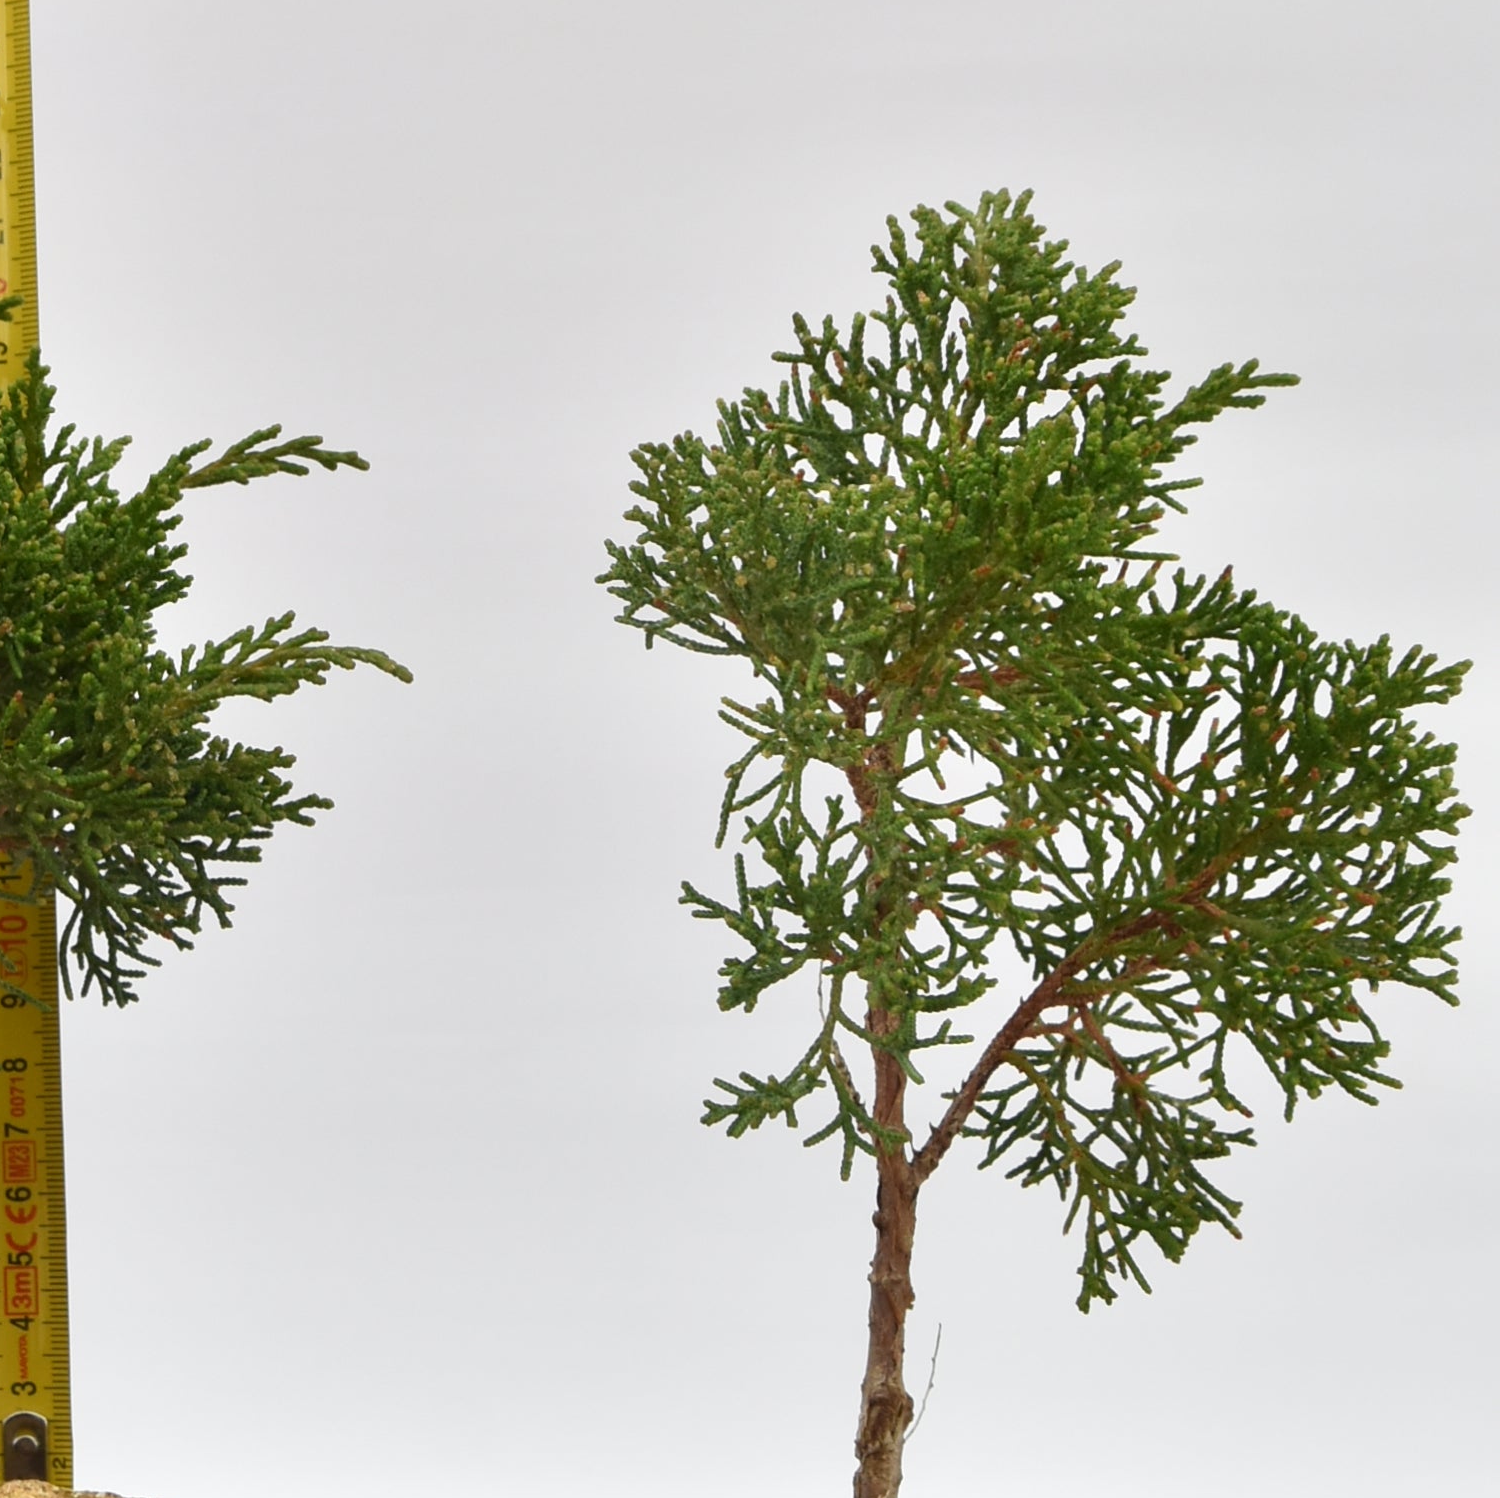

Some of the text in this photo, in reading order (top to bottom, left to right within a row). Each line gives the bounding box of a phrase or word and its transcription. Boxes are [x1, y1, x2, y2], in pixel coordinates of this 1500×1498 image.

[0, 993, 26, 1009] 9
[2, 1057, 28, 1073] 8
[9, 1076, 26, 1118] 0071
[4, 1123, 29, 1138] 7
[7, 1145, 31, 1179] M23
[5, 1186, 32, 1202] 6
[7, 1252, 33, 1266] 5
[12, 1271, 32, 1309] 3m
[10, 1315, 35, 1331] 4
[11, 1381, 37, 1396] 3
[53, 1457, 68, 1470] 2
